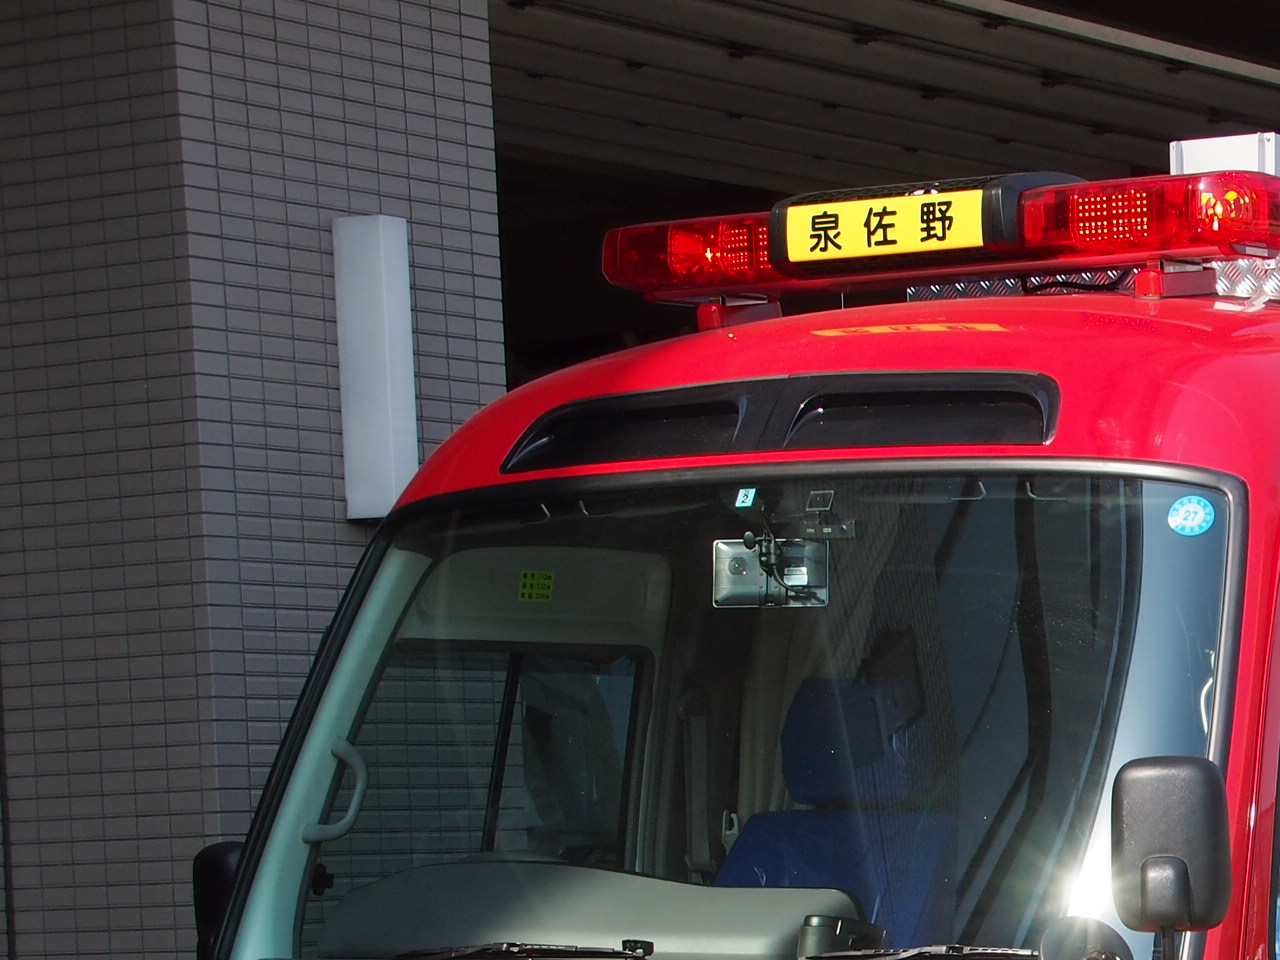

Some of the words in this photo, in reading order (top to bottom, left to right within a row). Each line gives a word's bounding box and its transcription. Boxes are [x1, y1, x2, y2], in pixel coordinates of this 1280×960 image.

[809, 200, 954, 253] 泉佐野
[1183, 510, 1199, 522] 27
